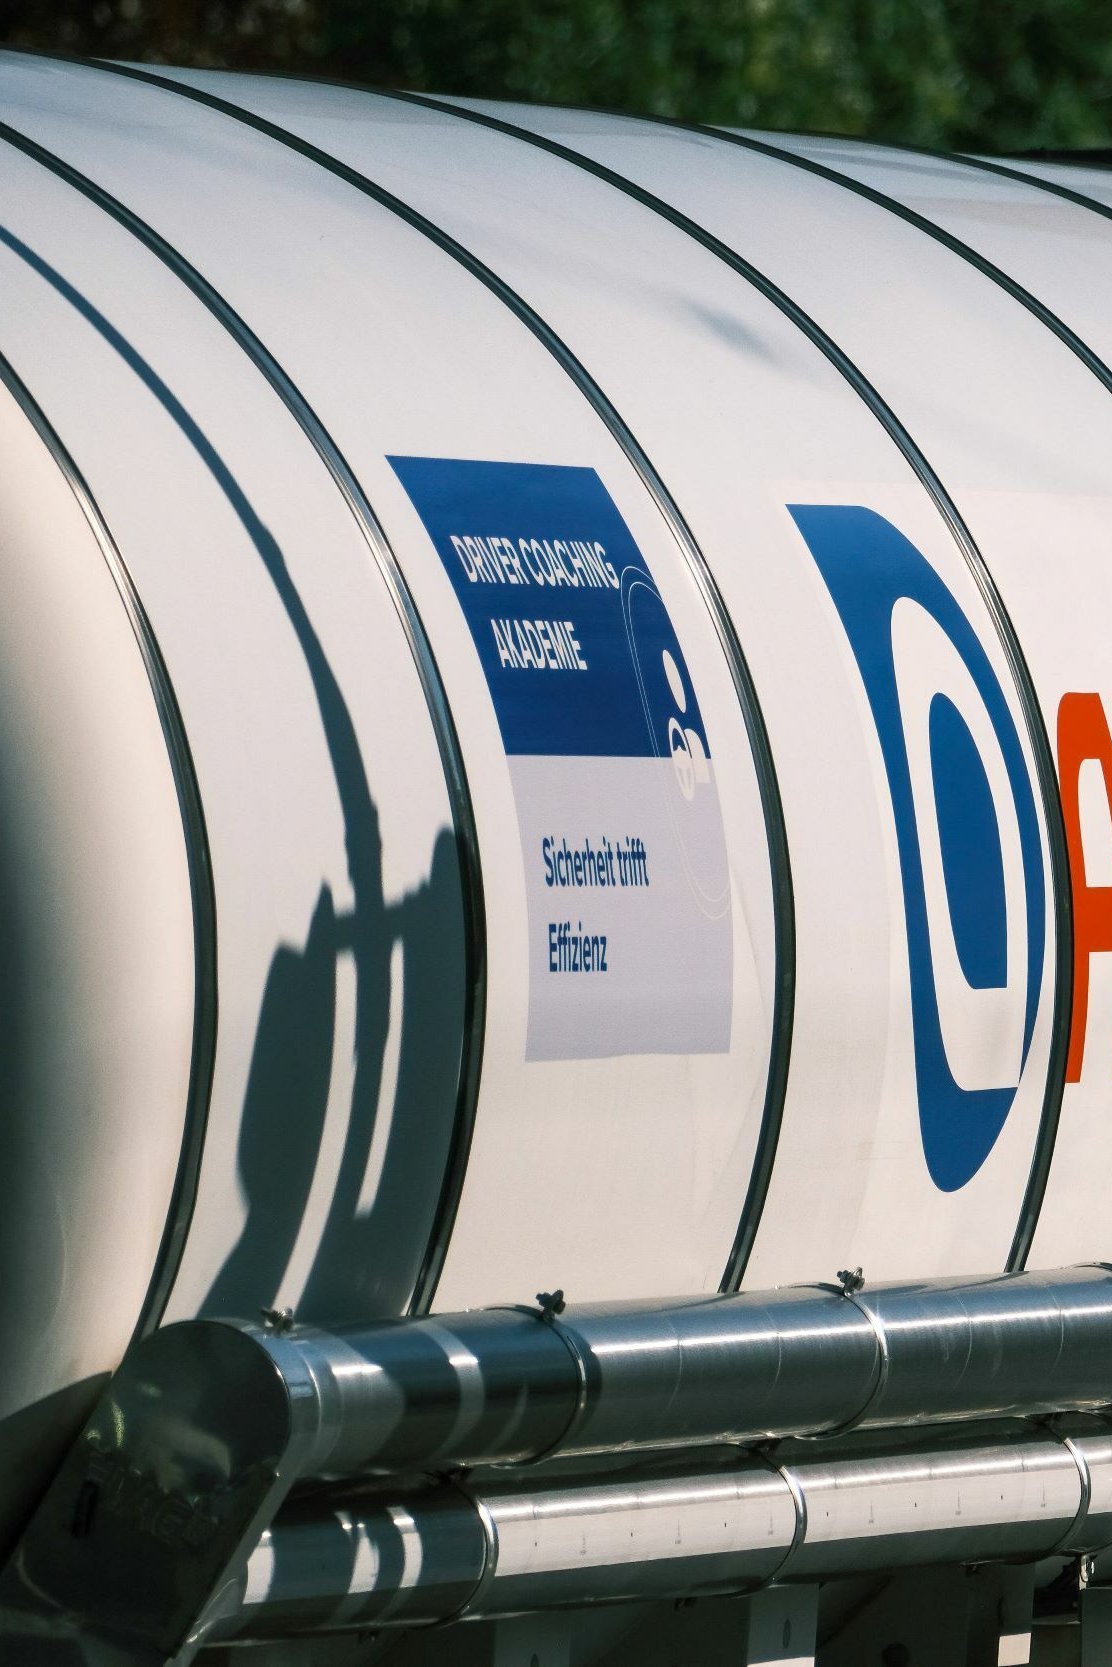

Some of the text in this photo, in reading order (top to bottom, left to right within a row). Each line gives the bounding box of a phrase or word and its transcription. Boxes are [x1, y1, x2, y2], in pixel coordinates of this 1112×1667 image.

[450, 535, 619, 589] DRIVER COACHING
[491, 619, 588, 670] AKADEMIE
[543, 836, 649, 887] Sicherheit trifft
[549, 921, 607, 972] Effizienz
